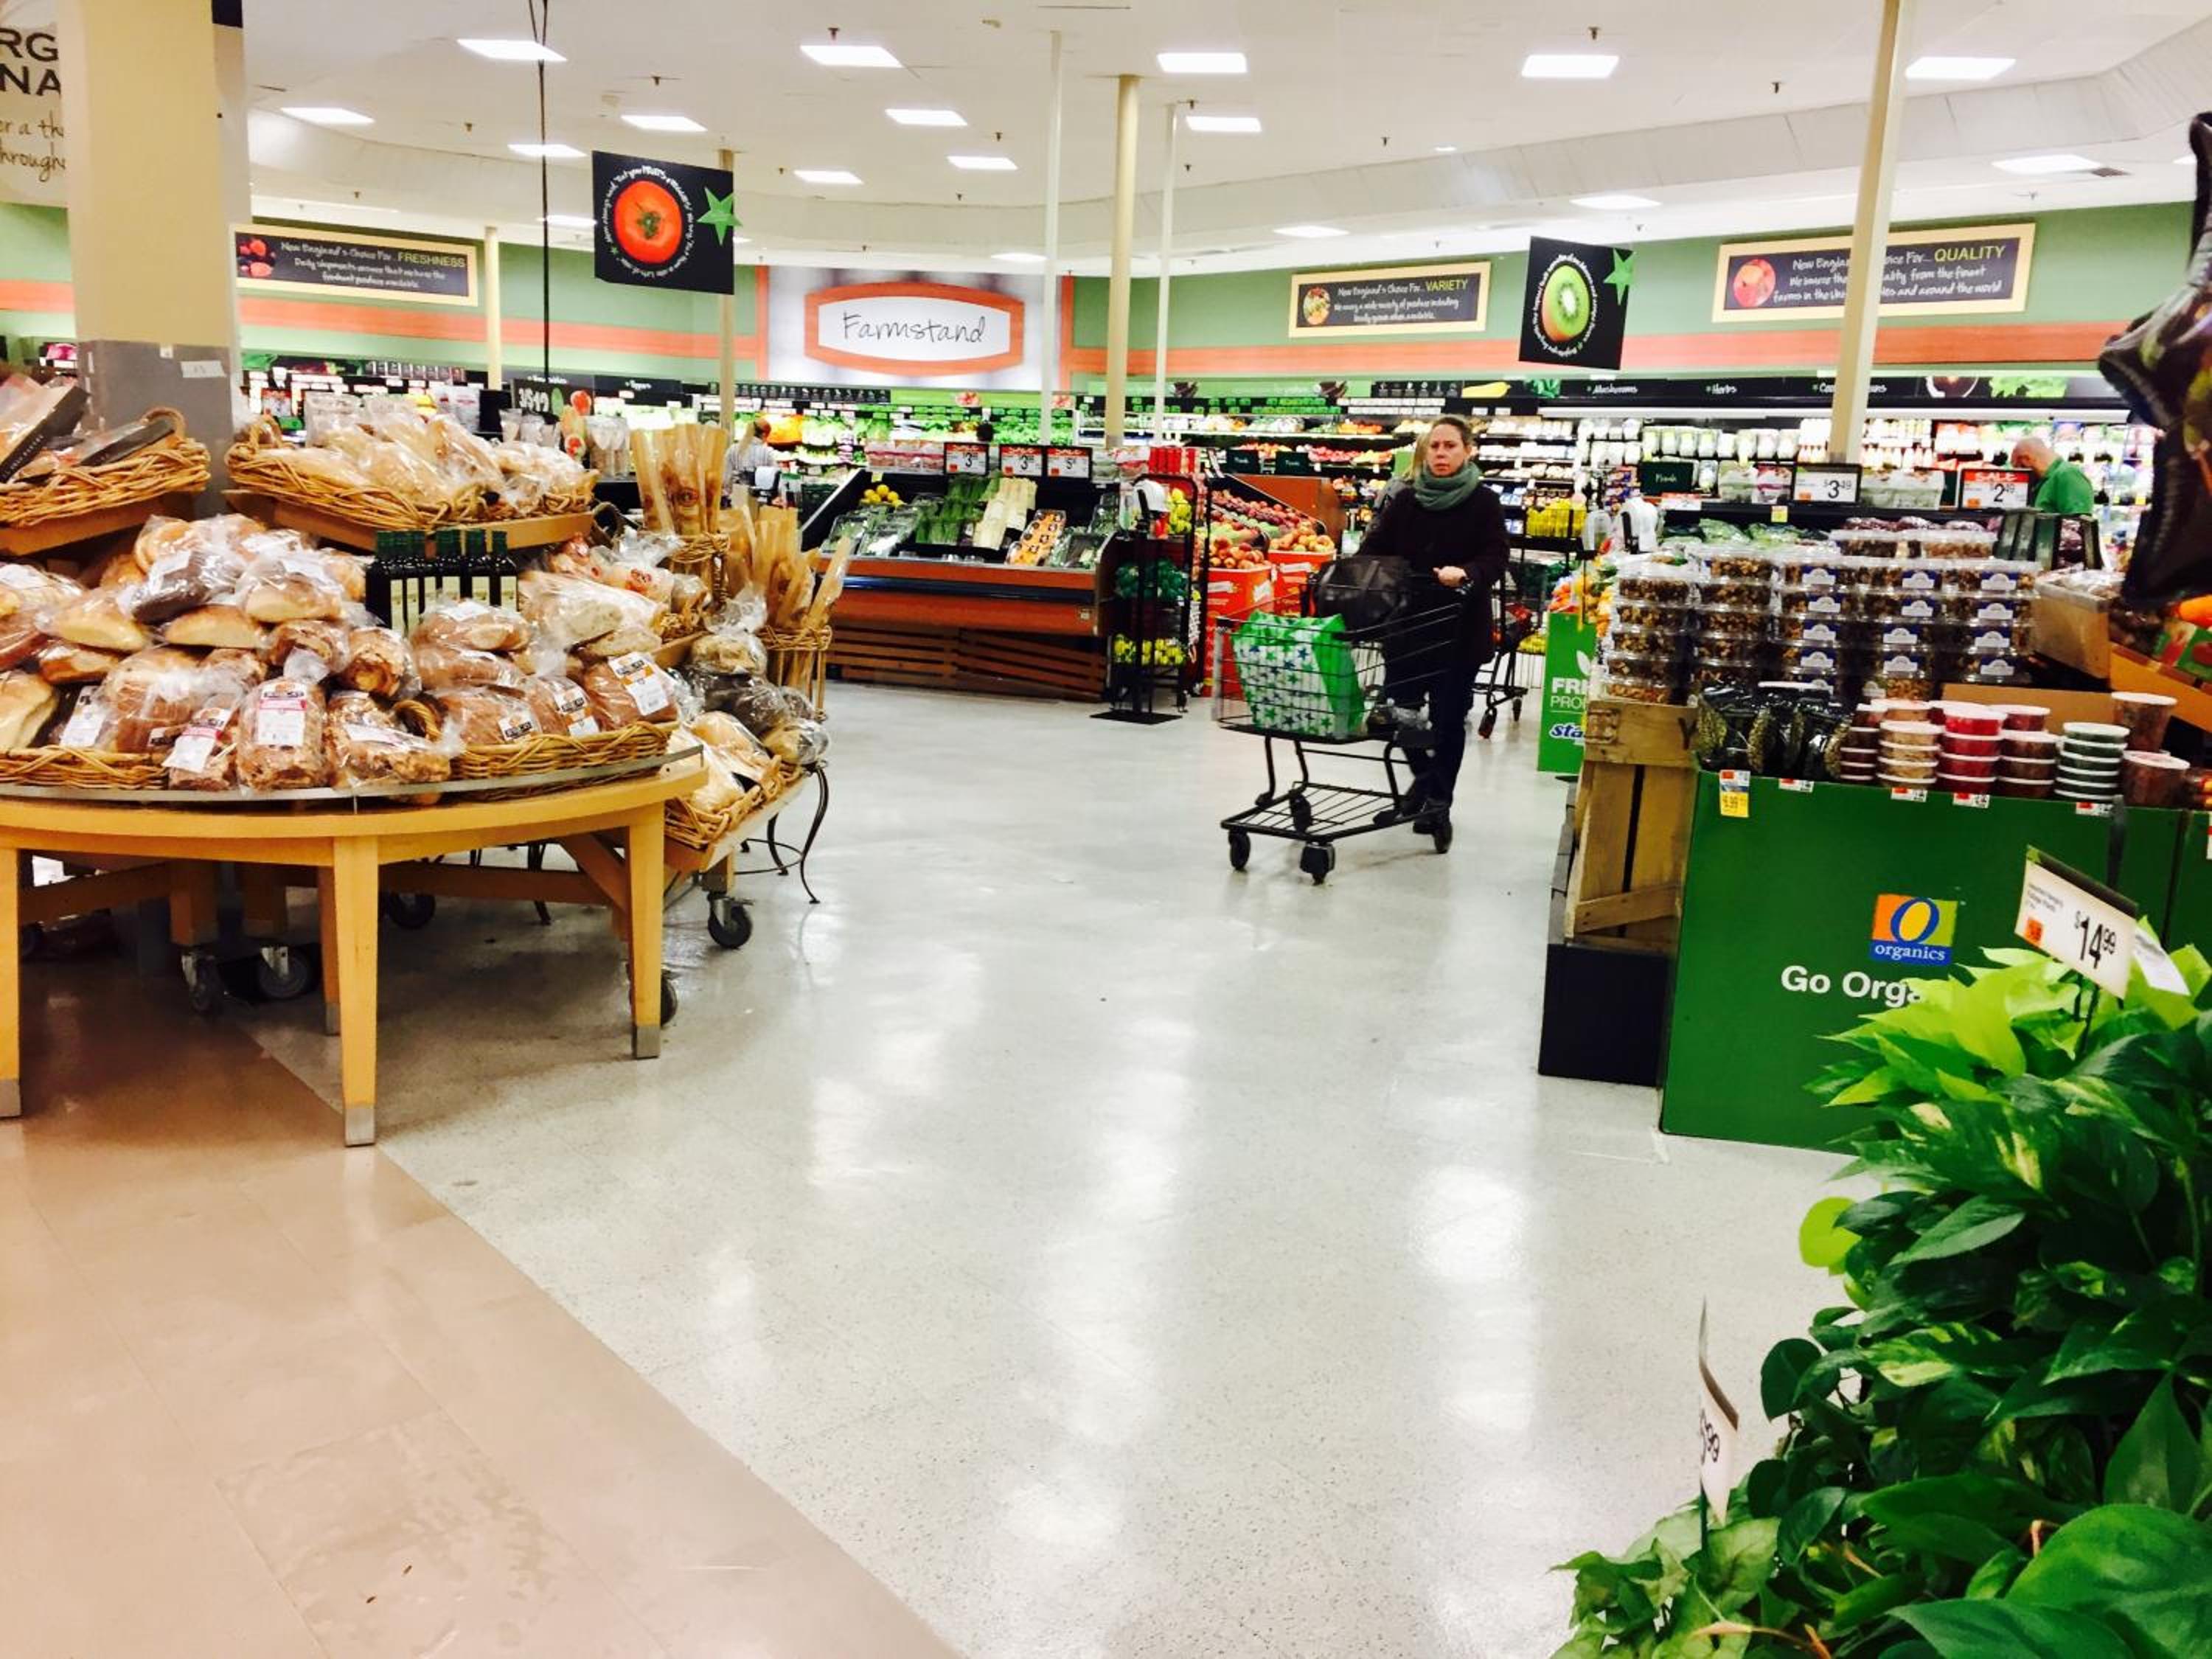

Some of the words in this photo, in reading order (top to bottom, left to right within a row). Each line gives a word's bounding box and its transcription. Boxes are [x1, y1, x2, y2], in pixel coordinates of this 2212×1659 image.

[398, 252, 465, 268] FRESHNESS
[1792, 259, 1815, 271] New
[1935, 245, 2006, 262] QUALITY
[1910, 267, 1935, 282] from
[1937, 265, 1954, 279] the
[1425, 279, 1468, 292] VARIETY
[842, 311, 986, 343] Farmstand
[1976, 472, 2017, 482] SALE
[1550, 695, 1586, 709] PRO
[1874, 944, 1946, 960] organics
[1780, 964, 1832, 994] Go
